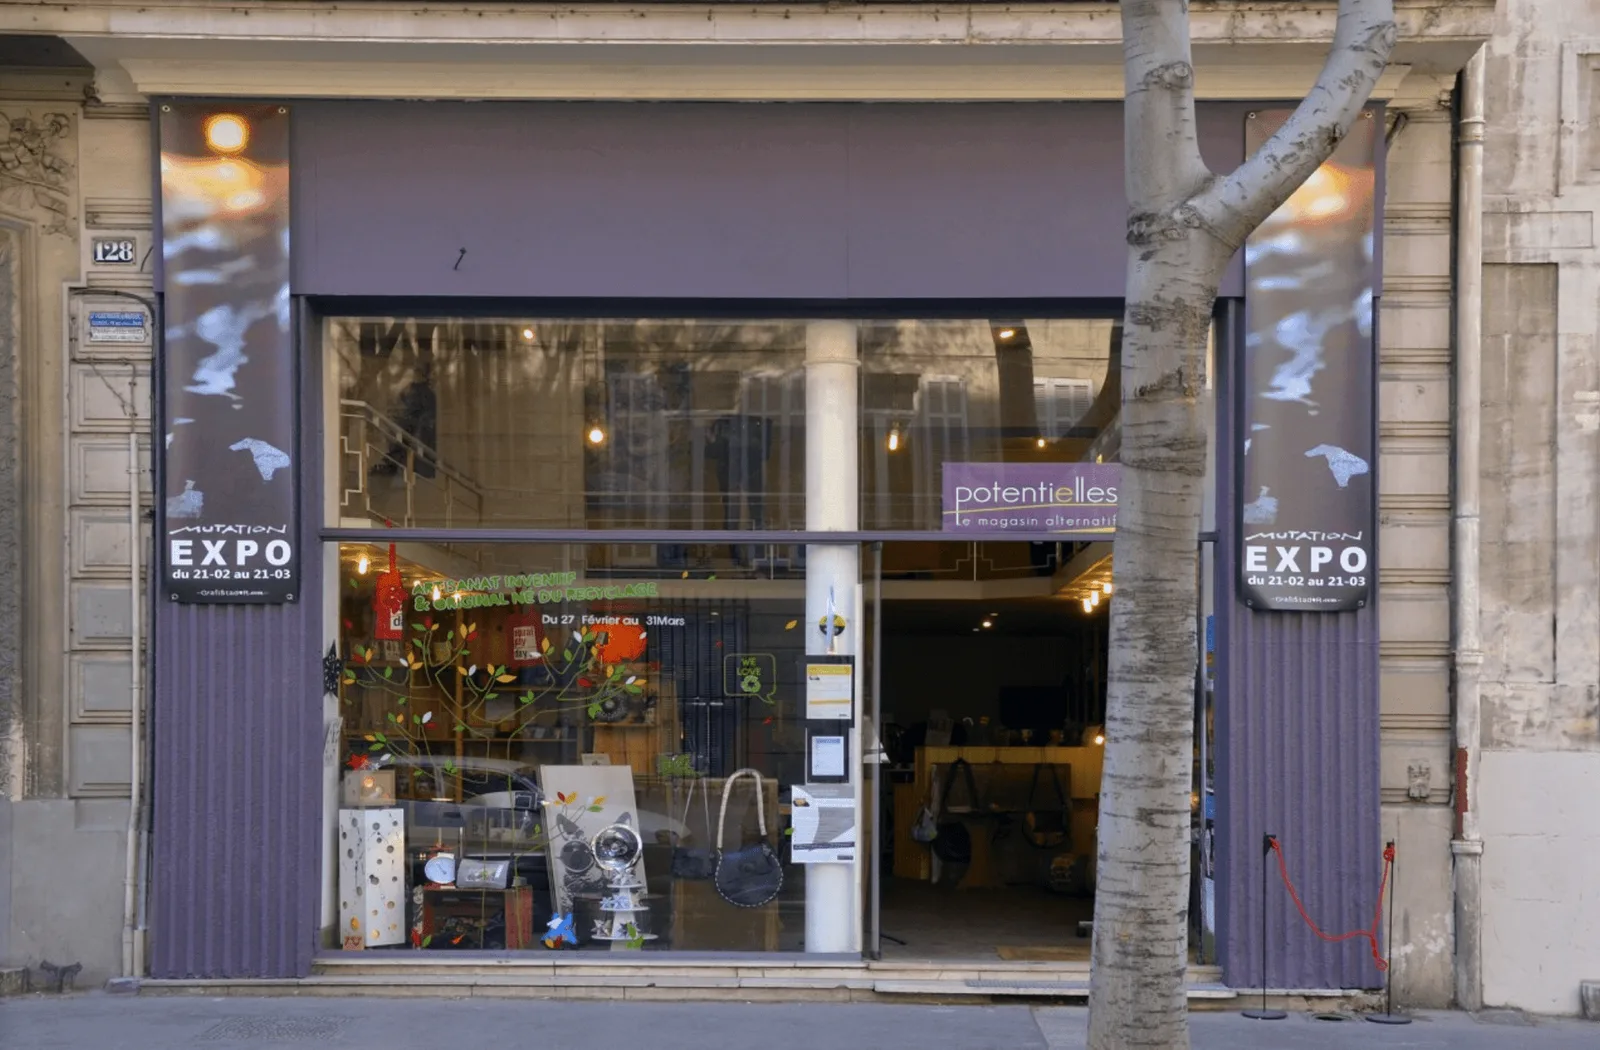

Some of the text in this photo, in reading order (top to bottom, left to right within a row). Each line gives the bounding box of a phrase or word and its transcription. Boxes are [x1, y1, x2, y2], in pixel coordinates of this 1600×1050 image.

[94, 240, 133, 262] 128
[955, 476, 1118, 523] potentielles
[978, 517, 1038, 529] magasin
[1045, 514, 1117, 527] alternatif
[168, 524, 287, 535] MUTATION
[1244, 531, 1363, 542] MUTATION
[171, 539, 292, 566] EXPO
[1246, 546, 1367, 573] EXPO
[172, 569, 291, 579] du 21-02 au 21-03
[412, 571, 577, 596] ARTISANAT INVENTIF
[1247, 575, 1366, 587] du 21-02 au 21-03
[414, 595, 430, 612] &
[432, 592, 510, 611] ORIGINAL
[538, 588, 562, 604] DU
[565, 582, 658, 602] RECYCLAGE
[541, 614, 558, 625] Du
[560, 614, 575, 625] 27
[581, 614, 620, 625] Février
[622, 616, 639, 625] au
[741, 656, 757, 665] WE
[736, 667, 762, 676] LOVE
